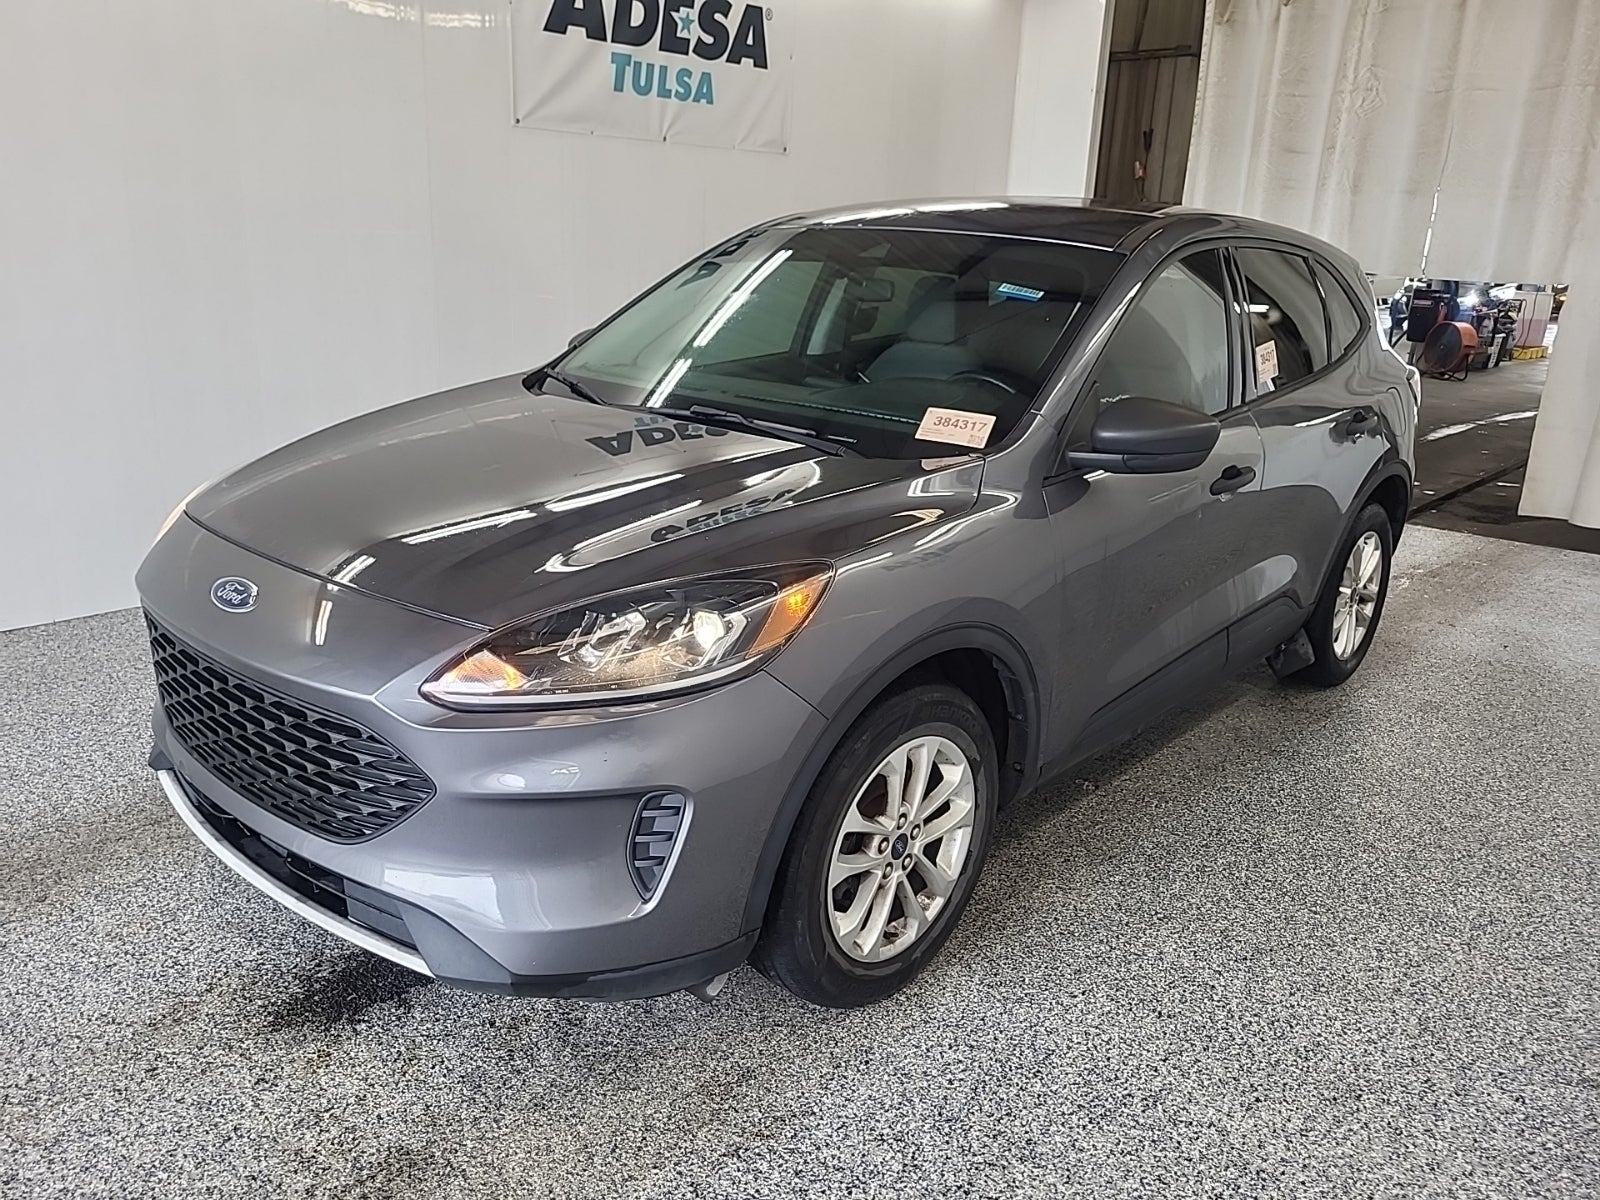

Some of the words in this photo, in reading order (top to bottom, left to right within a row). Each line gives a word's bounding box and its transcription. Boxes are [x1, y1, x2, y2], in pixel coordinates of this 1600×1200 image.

[543, 0, 768, 69] ADESA
[611, 52, 714, 104] TULSA
[933, 416, 987, 432] 384317
[217, 582, 248, 604] Ford
